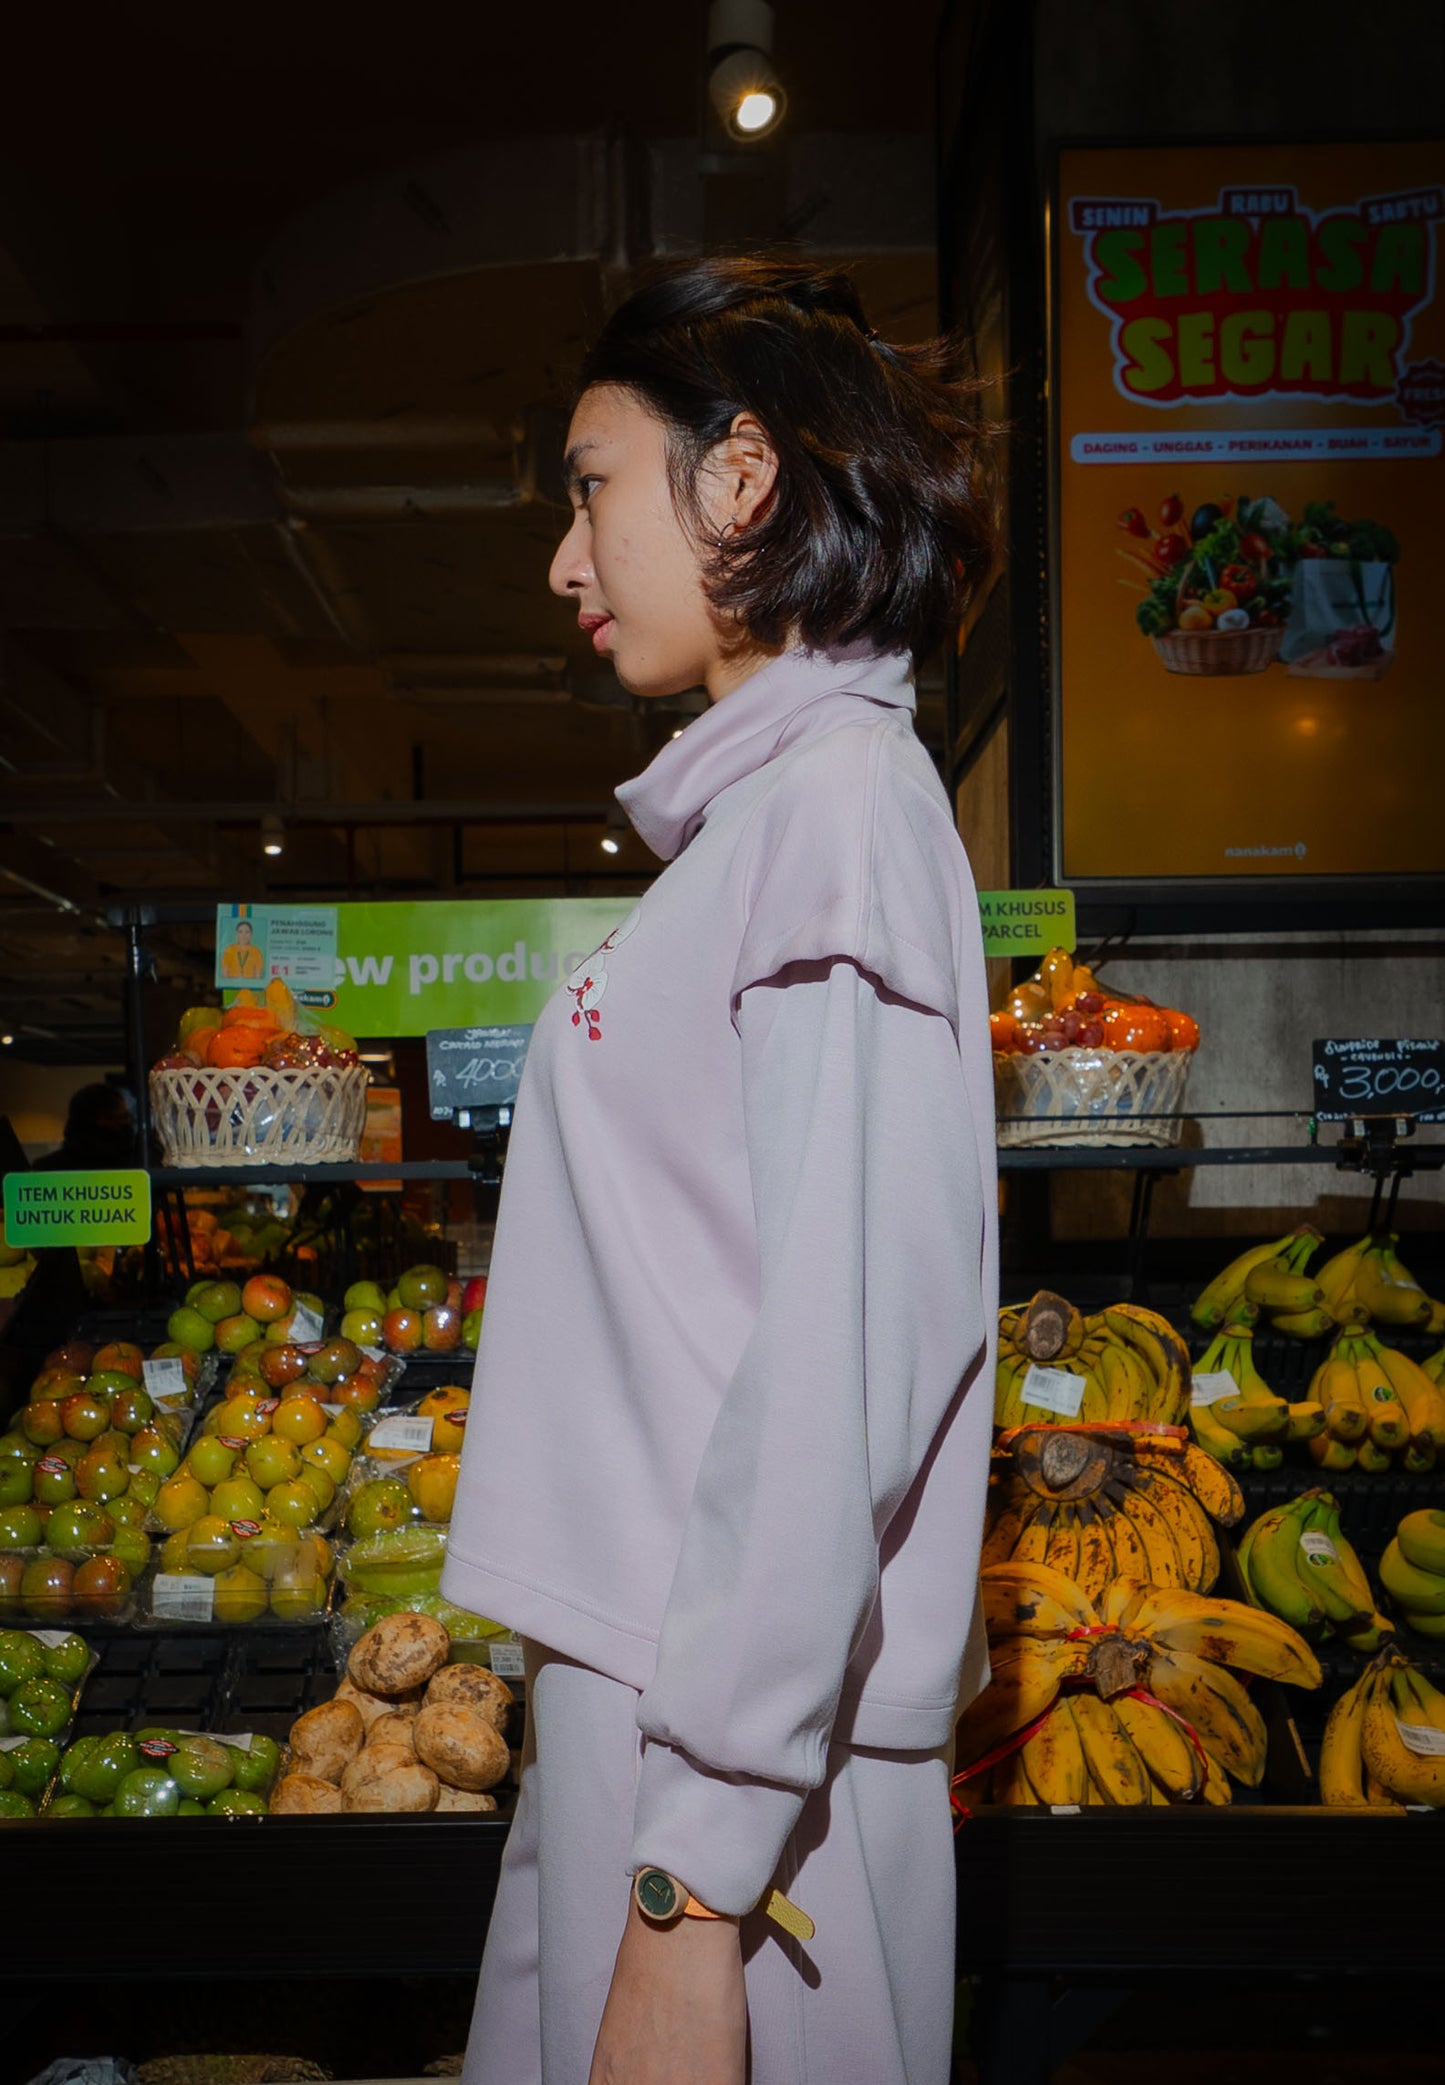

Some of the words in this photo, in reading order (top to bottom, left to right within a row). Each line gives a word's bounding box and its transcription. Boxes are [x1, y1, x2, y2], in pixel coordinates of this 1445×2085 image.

[1231, 193, 1289, 213] RABU
[1367, 194, 1438, 224] SABTU
[1081, 205, 1149, 227] SENIN
[1097, 217, 1425, 302] SERASA
[1120, 309, 1399, 392] SEGAR
[1083, 443, 1138, 454] DAGING
[1153, 441, 1213, 453] UNGGAS
[1229, 439, 1313, 452] PERIKANAN
[1328, 438, 1368, 449] BUAH
[1383, 436, 1431, 449] SAYUR
[996, 901, 1066, 916] KHUSUS
[19, 1187, 57, 1202] ITEM
[62, 1185, 133, 1201] KHUSUS
[16, 1209, 75, 1225] UNTUK
[80, 1207, 136, 1224] RUJAK
